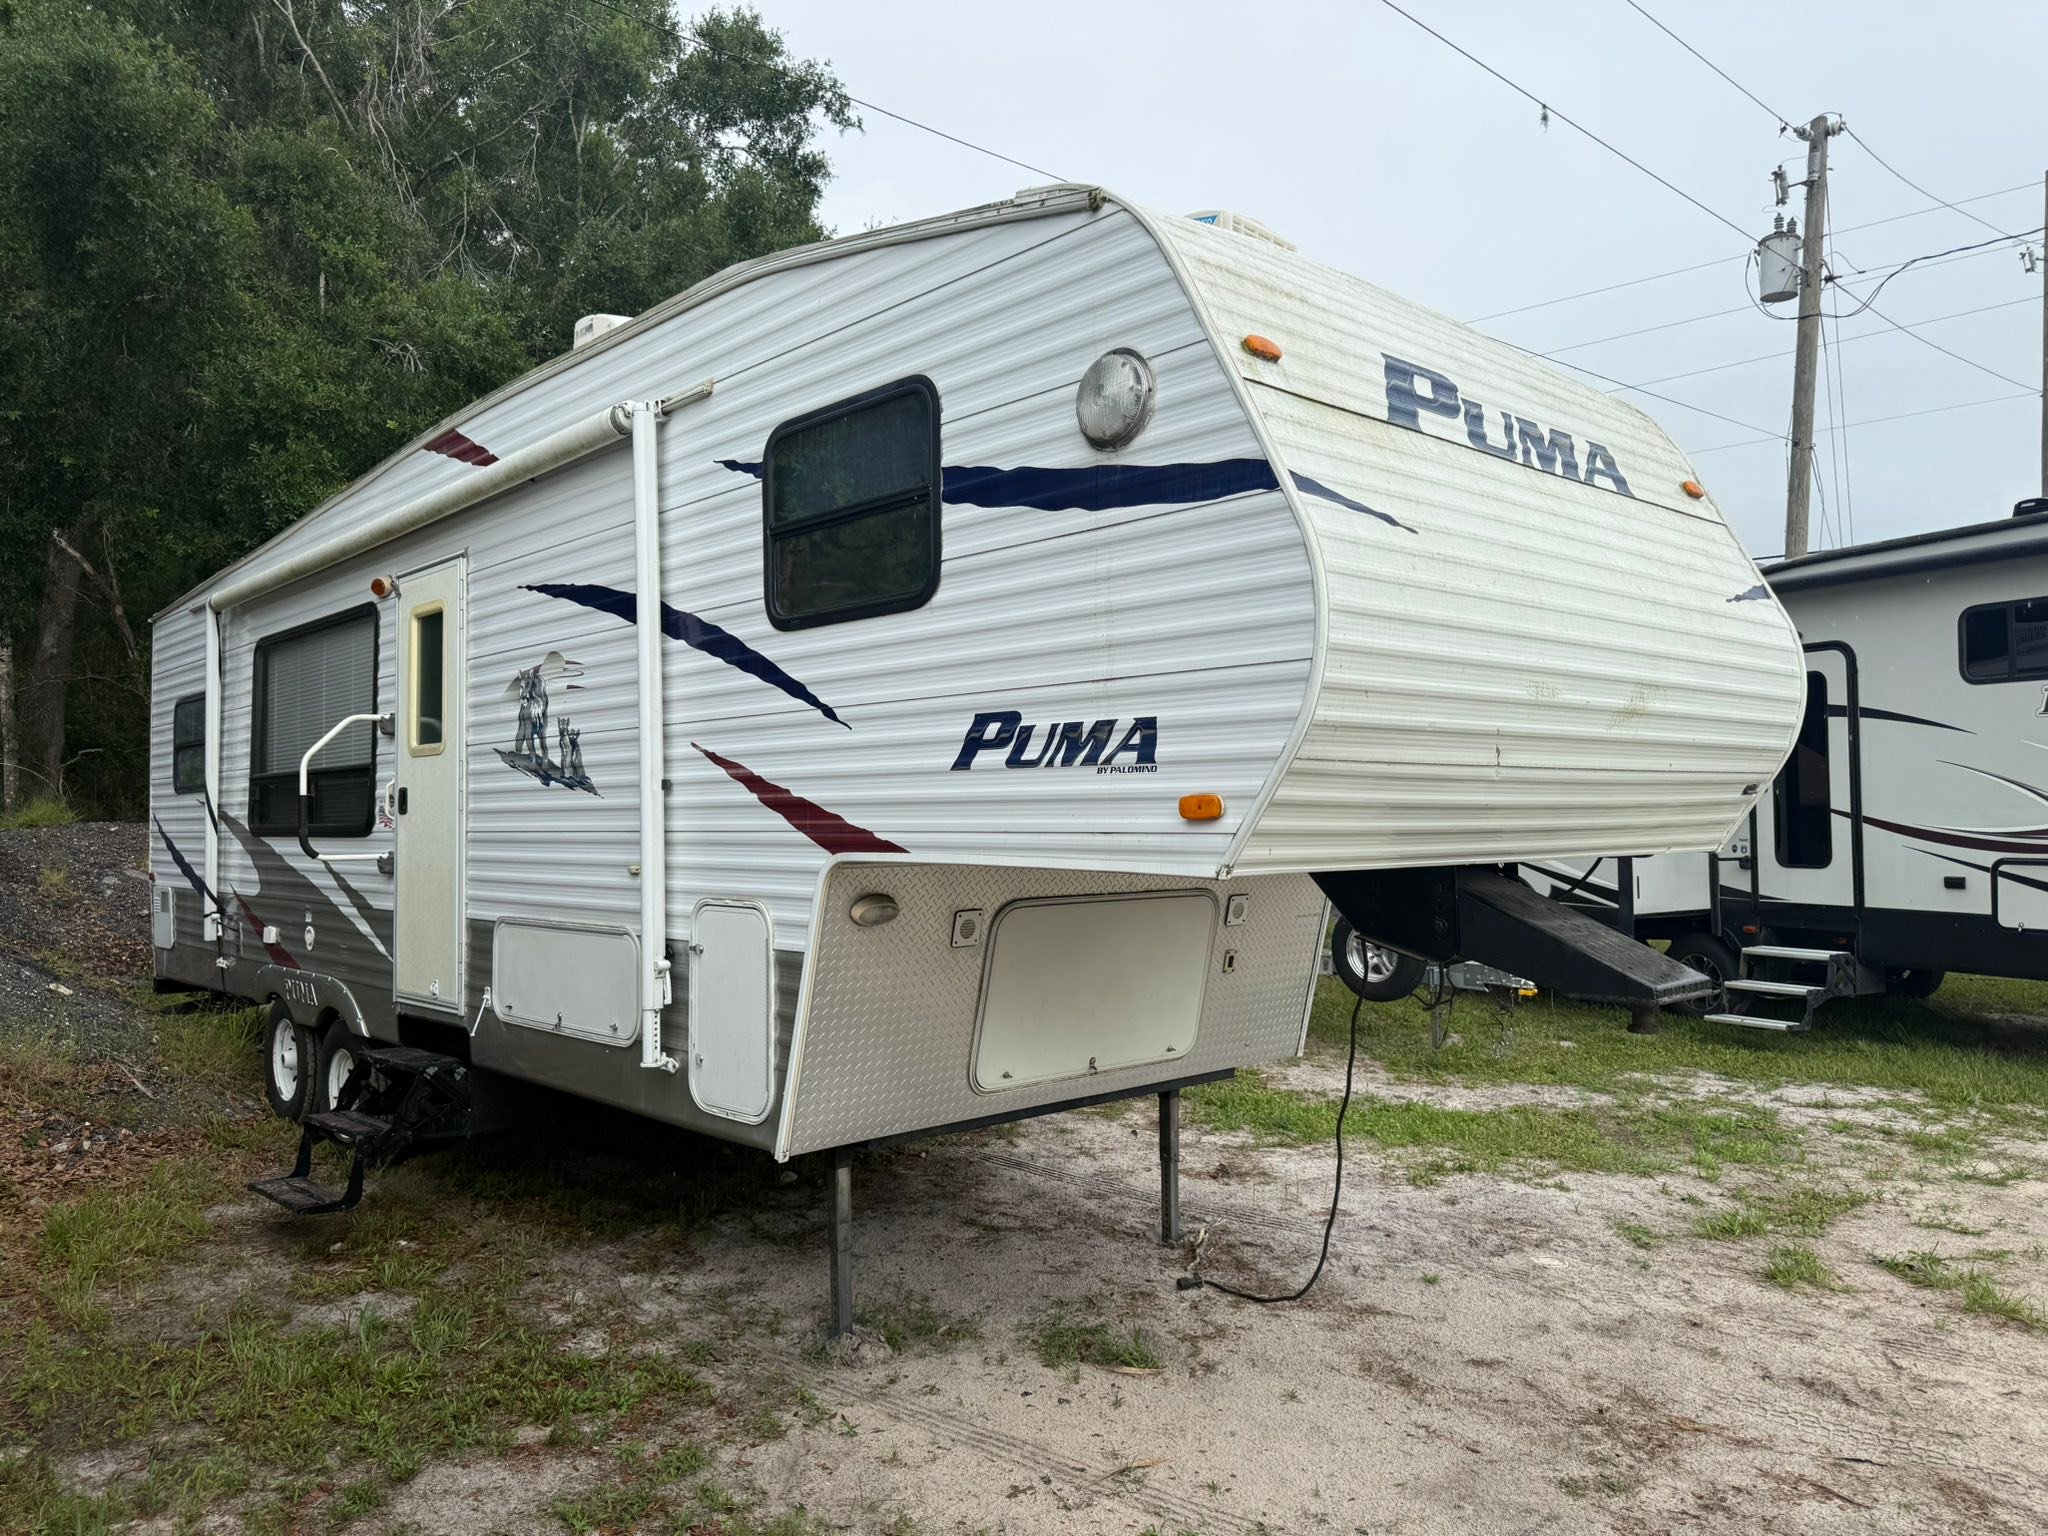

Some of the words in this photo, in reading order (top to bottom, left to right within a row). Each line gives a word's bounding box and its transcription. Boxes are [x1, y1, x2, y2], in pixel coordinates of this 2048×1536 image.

[1380, 352, 1636, 499] PUMA
[950, 710, 1158, 771] PUMA
[1096, 766, 1109, 774] BY
[1109, 765, 1158, 774] PALOMINO
